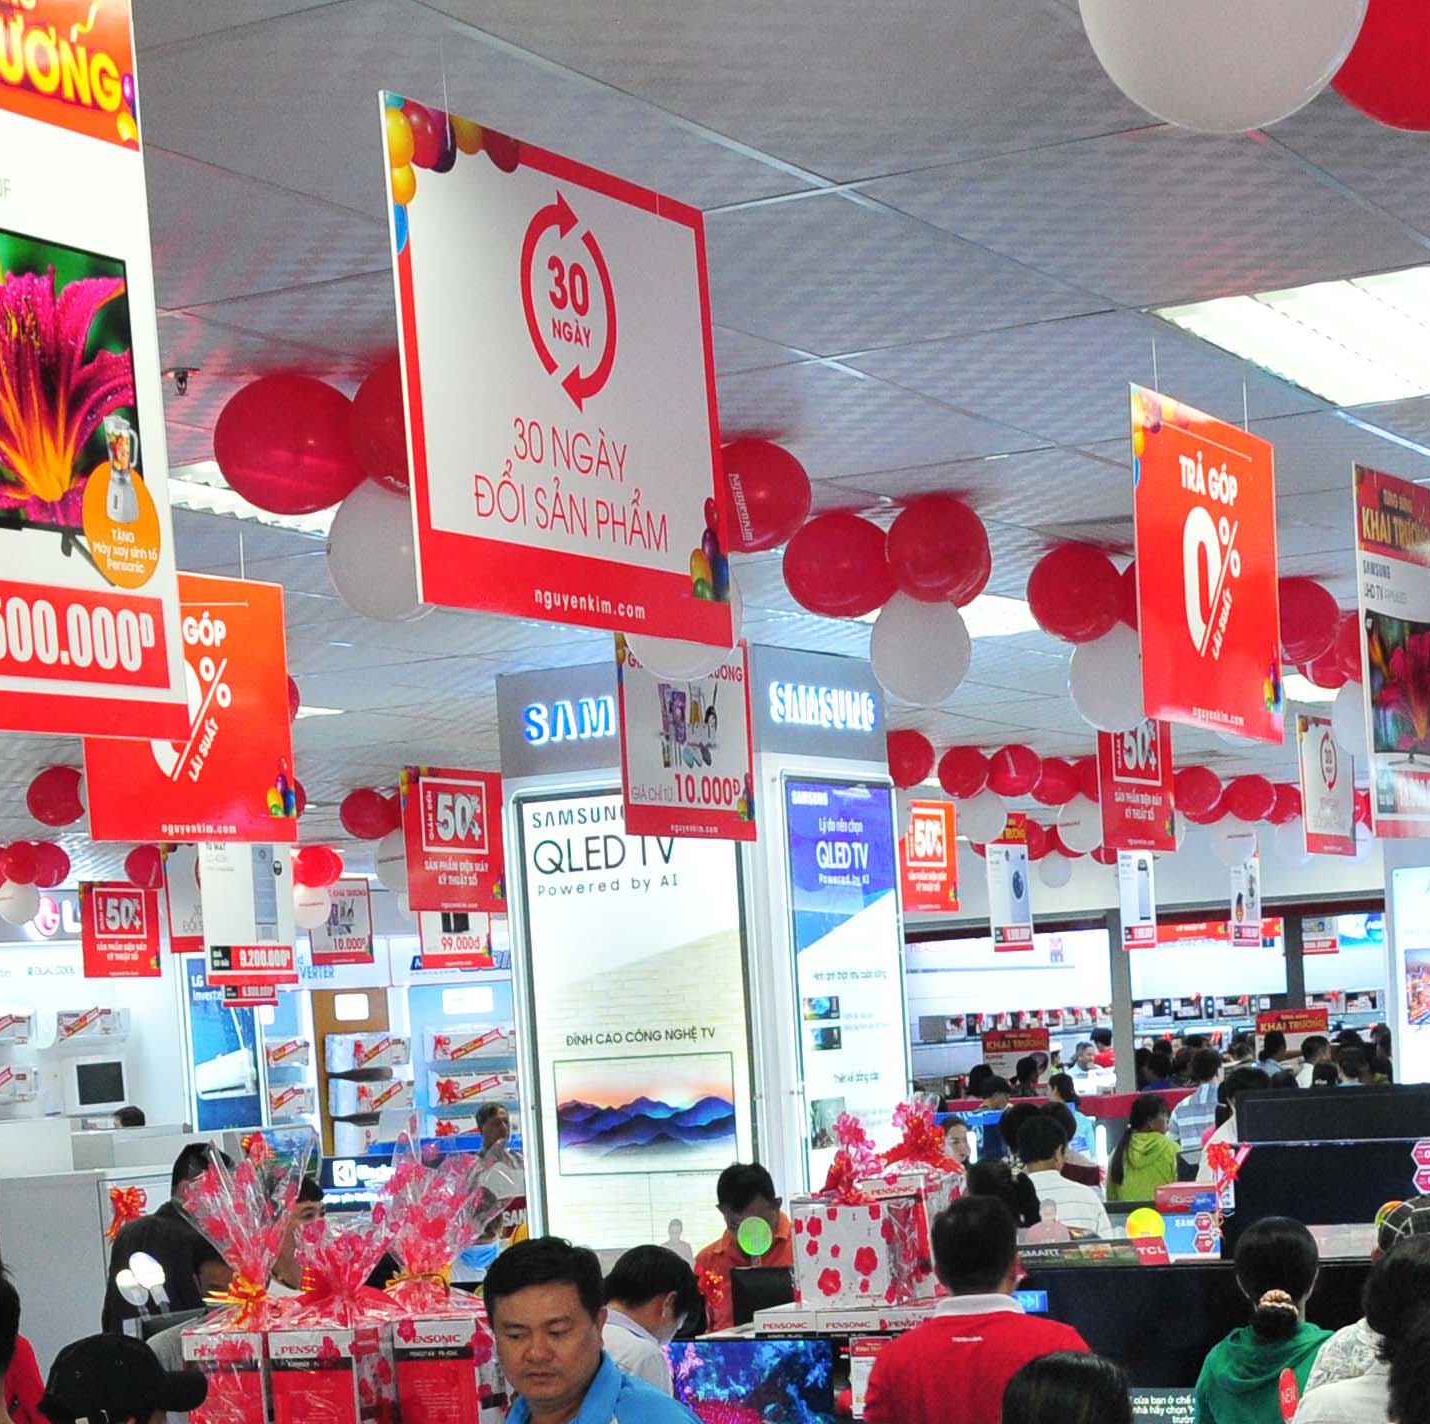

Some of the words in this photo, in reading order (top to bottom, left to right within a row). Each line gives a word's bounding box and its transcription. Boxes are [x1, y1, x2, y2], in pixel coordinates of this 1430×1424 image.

[546, 255, 589, 317] 30
[552, 316, 591, 348] NGÀY
[513, 417, 544, 463] 30
[551, 424, 627, 483] NGÀY
[1179, 451, 1206, 496] TRẢ
[1208, 464, 1238, 507] GÓP
[474, 458, 527, 528] ĐỔI
[535, 475, 588, 535] SẢN
[595, 487, 669, 554] PHẨM
[1183, 505, 1242, 657] 0%
[533, 587, 646, 621] nguyenkim.com
[182, 614, 227, 648] GÓP
[769, 681, 876, 732] SAMSUNG
[675, 772, 741, 806] 10.000Đ
[161, 822, 238, 836] nguyenkim.com
[533, 834, 627, 874] QLED
[639, 835, 677, 867] TV
[816, 841, 851, 870] QLED
[852, 842, 869, 870] TV
[537, 878, 621, 897] Powered
[631, 875, 652, 893] by
[658, 873, 679, 888] AI
[191, 975, 204, 988] LG
[565, 1030, 594, 1046] ĐỈNH
[596, 1032, 622, 1045] CAO
[625, 1027, 662, 1044] CÔNG
[665, 1027, 697, 1043] NGHỆ
[700, 1027, 716, 1041] TV
[763, 1321, 808, 1329] PENSONIC
